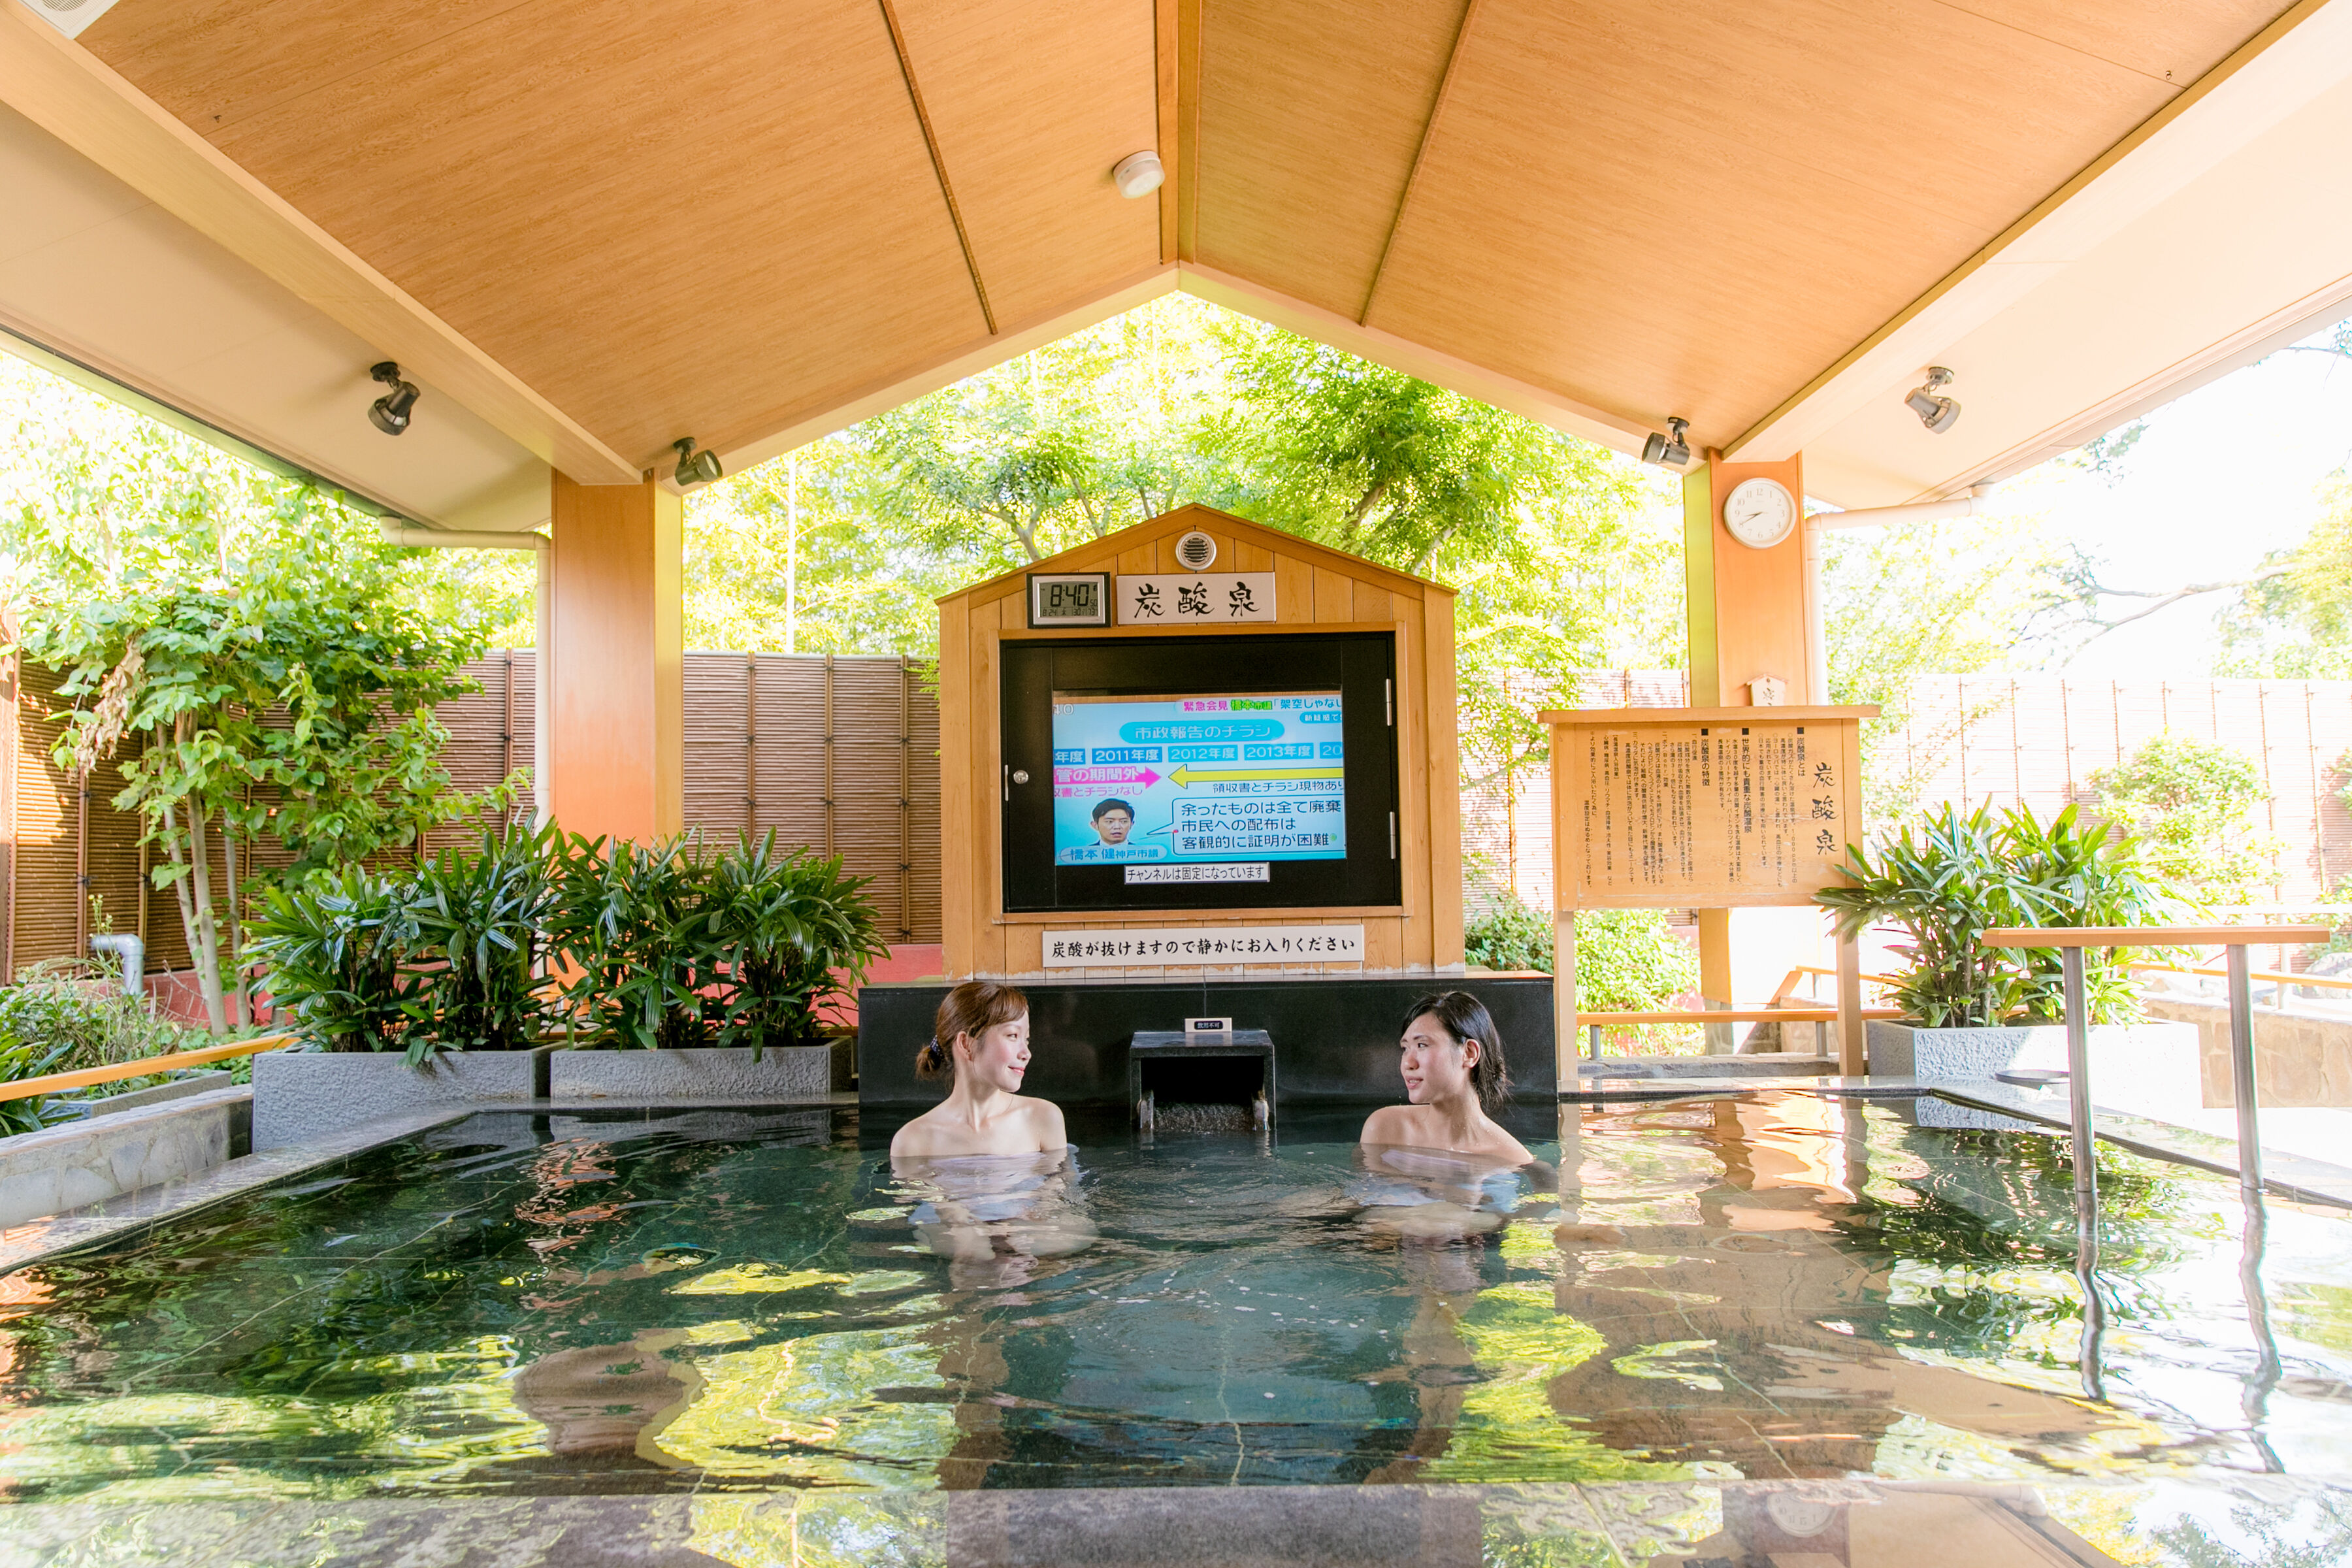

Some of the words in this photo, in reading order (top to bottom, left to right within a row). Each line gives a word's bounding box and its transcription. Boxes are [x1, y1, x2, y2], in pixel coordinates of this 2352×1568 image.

[1050, 584, 1089, 607] 8:40
[1134, 581, 1260, 617] 炭酸泉
[1135, 725, 1271, 740] 市政報告のチラシ
[1095, 749, 1159, 762] 2011年度
[1171, 747, 1235, 760] 2012年度
[1247, 745, 1311, 758] 2013年度
[1054, 767, 1139, 783] 管の期間外
[1181, 799, 1341, 816] 余ったものは全て廃棄
[1812, 761, 1838, 855] 炭酸泉
[1182, 817, 1296, 833] 市民への配布は
[1182, 833, 1330, 849] 客観的に証明が困難
[1128, 864, 1265, 881] チャンネルは固定になっています
[1051, 937, 1356, 958] 炭酸が抜けますので静かにお入りください
